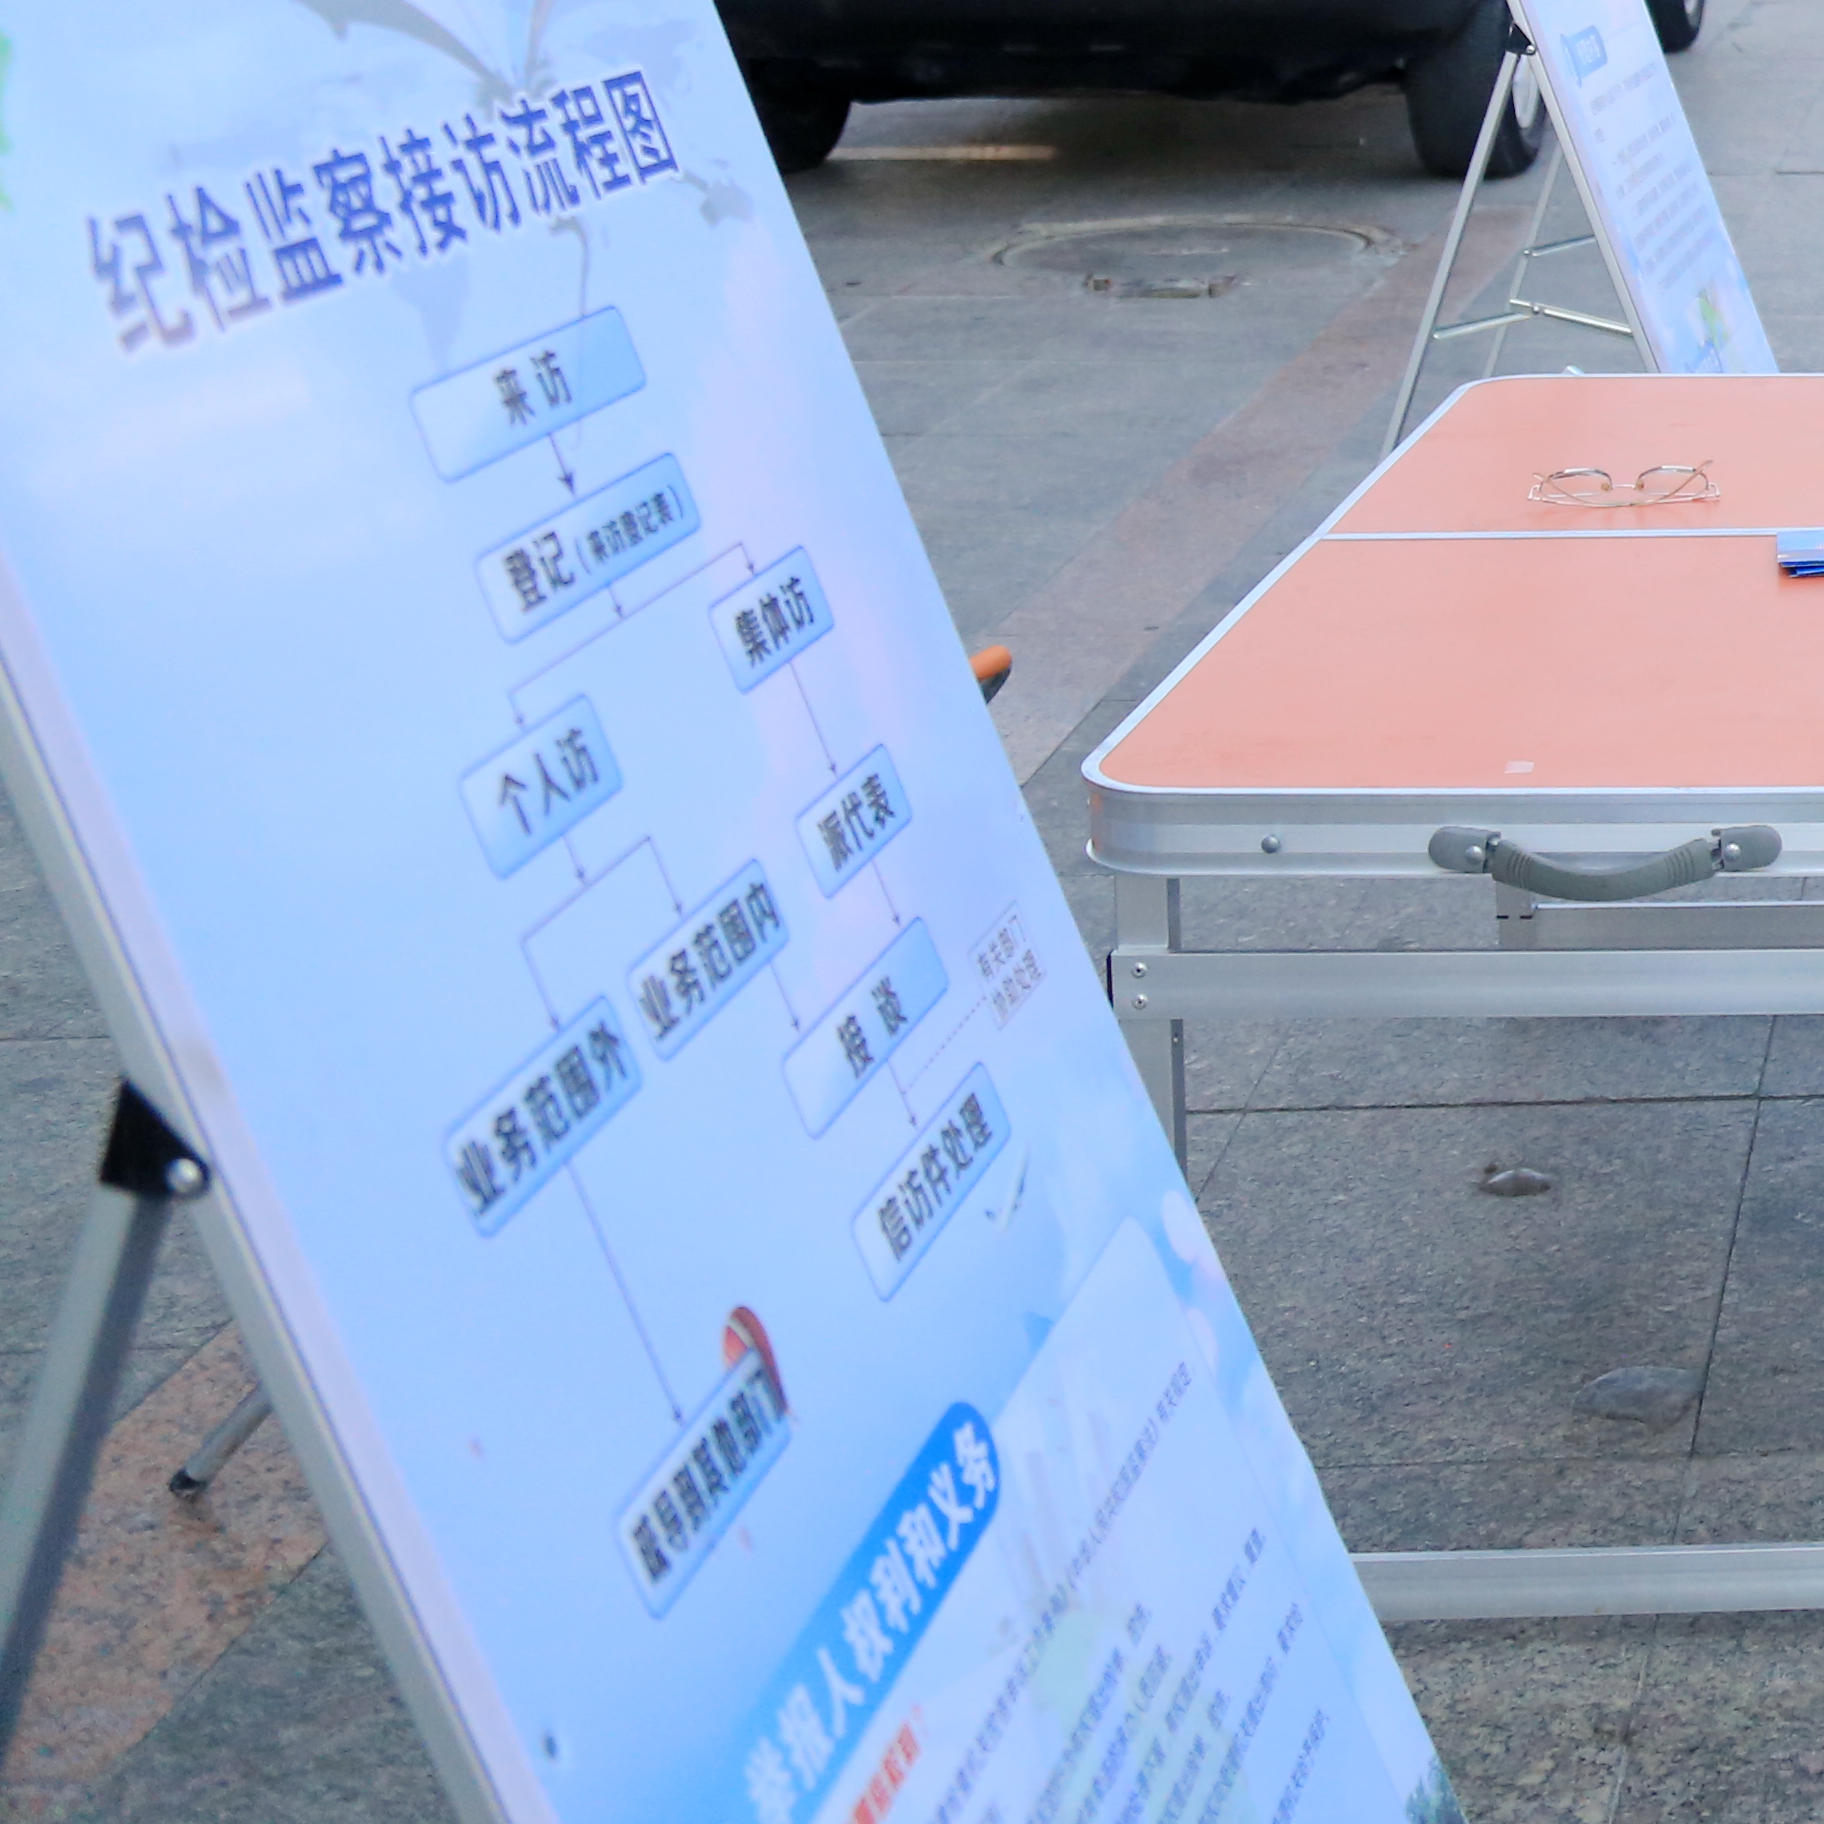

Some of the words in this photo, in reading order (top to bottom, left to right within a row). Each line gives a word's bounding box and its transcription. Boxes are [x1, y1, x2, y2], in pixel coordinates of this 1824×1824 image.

[85, 69, 681, 353] 纪检监察接访流程图
[492, 349, 573, 427] 来访
[734, 574, 815, 667] 集体访
[497, 726, 601, 837] 个人访
[817, 772, 897, 872] 派代表
[637, 880, 781, 1042] 业务范围内
[835, 976, 909, 1080] 接谈
[456, 1020, 629, 1217] 业务范围外
[876, 1090, 994, 1263] 信访件处理
[745, 1420, 997, 1824] 举报人权利和义务
